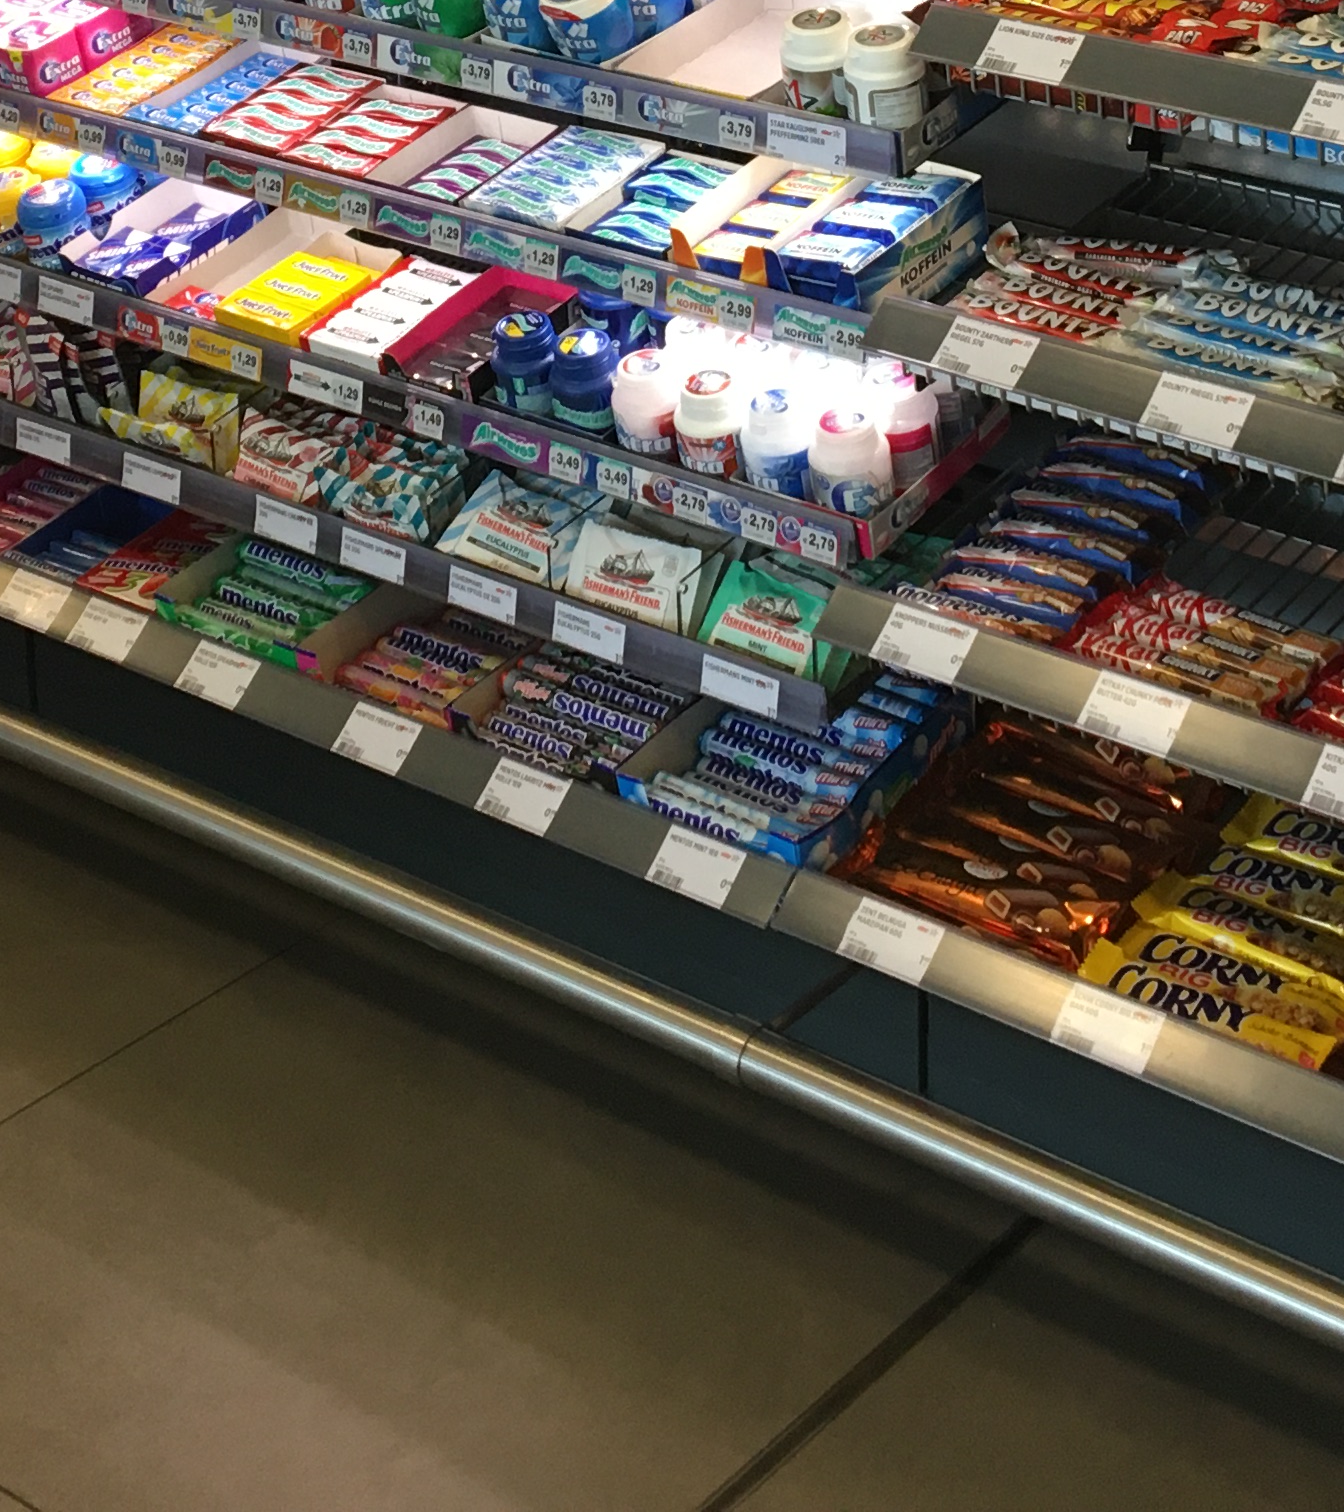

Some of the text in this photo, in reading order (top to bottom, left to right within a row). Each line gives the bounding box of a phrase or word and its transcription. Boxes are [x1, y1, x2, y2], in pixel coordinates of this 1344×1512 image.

[899, 239, 953, 289] KOFFEIN
[675, 296, 715, 317] KOFFEIN
[968, 294, 1110, 340] BOUNTY
[783, 326, 824, 346] KOFFEIN
[476, 511, 526, 544] FISHERMAN'S
[247, 540, 328, 581] mentos
[485, 533, 530, 559] EUCALYPTUS
[222, 587, 299, 626] mentos
[629, 589, 661, 611] FRIEND
[721, 612, 806, 655] FISHERMAN'S FRIEND
[747, 639, 769, 653] MINT
[1204, 634, 1259, 661] CHUNKY
[1163, 654, 1221, 682] CHUNKY
[728, 716, 826, 766] mentos
[1140, 932, 1287, 995] CORNY
[1108, 963, 1255, 1033] CORNY
